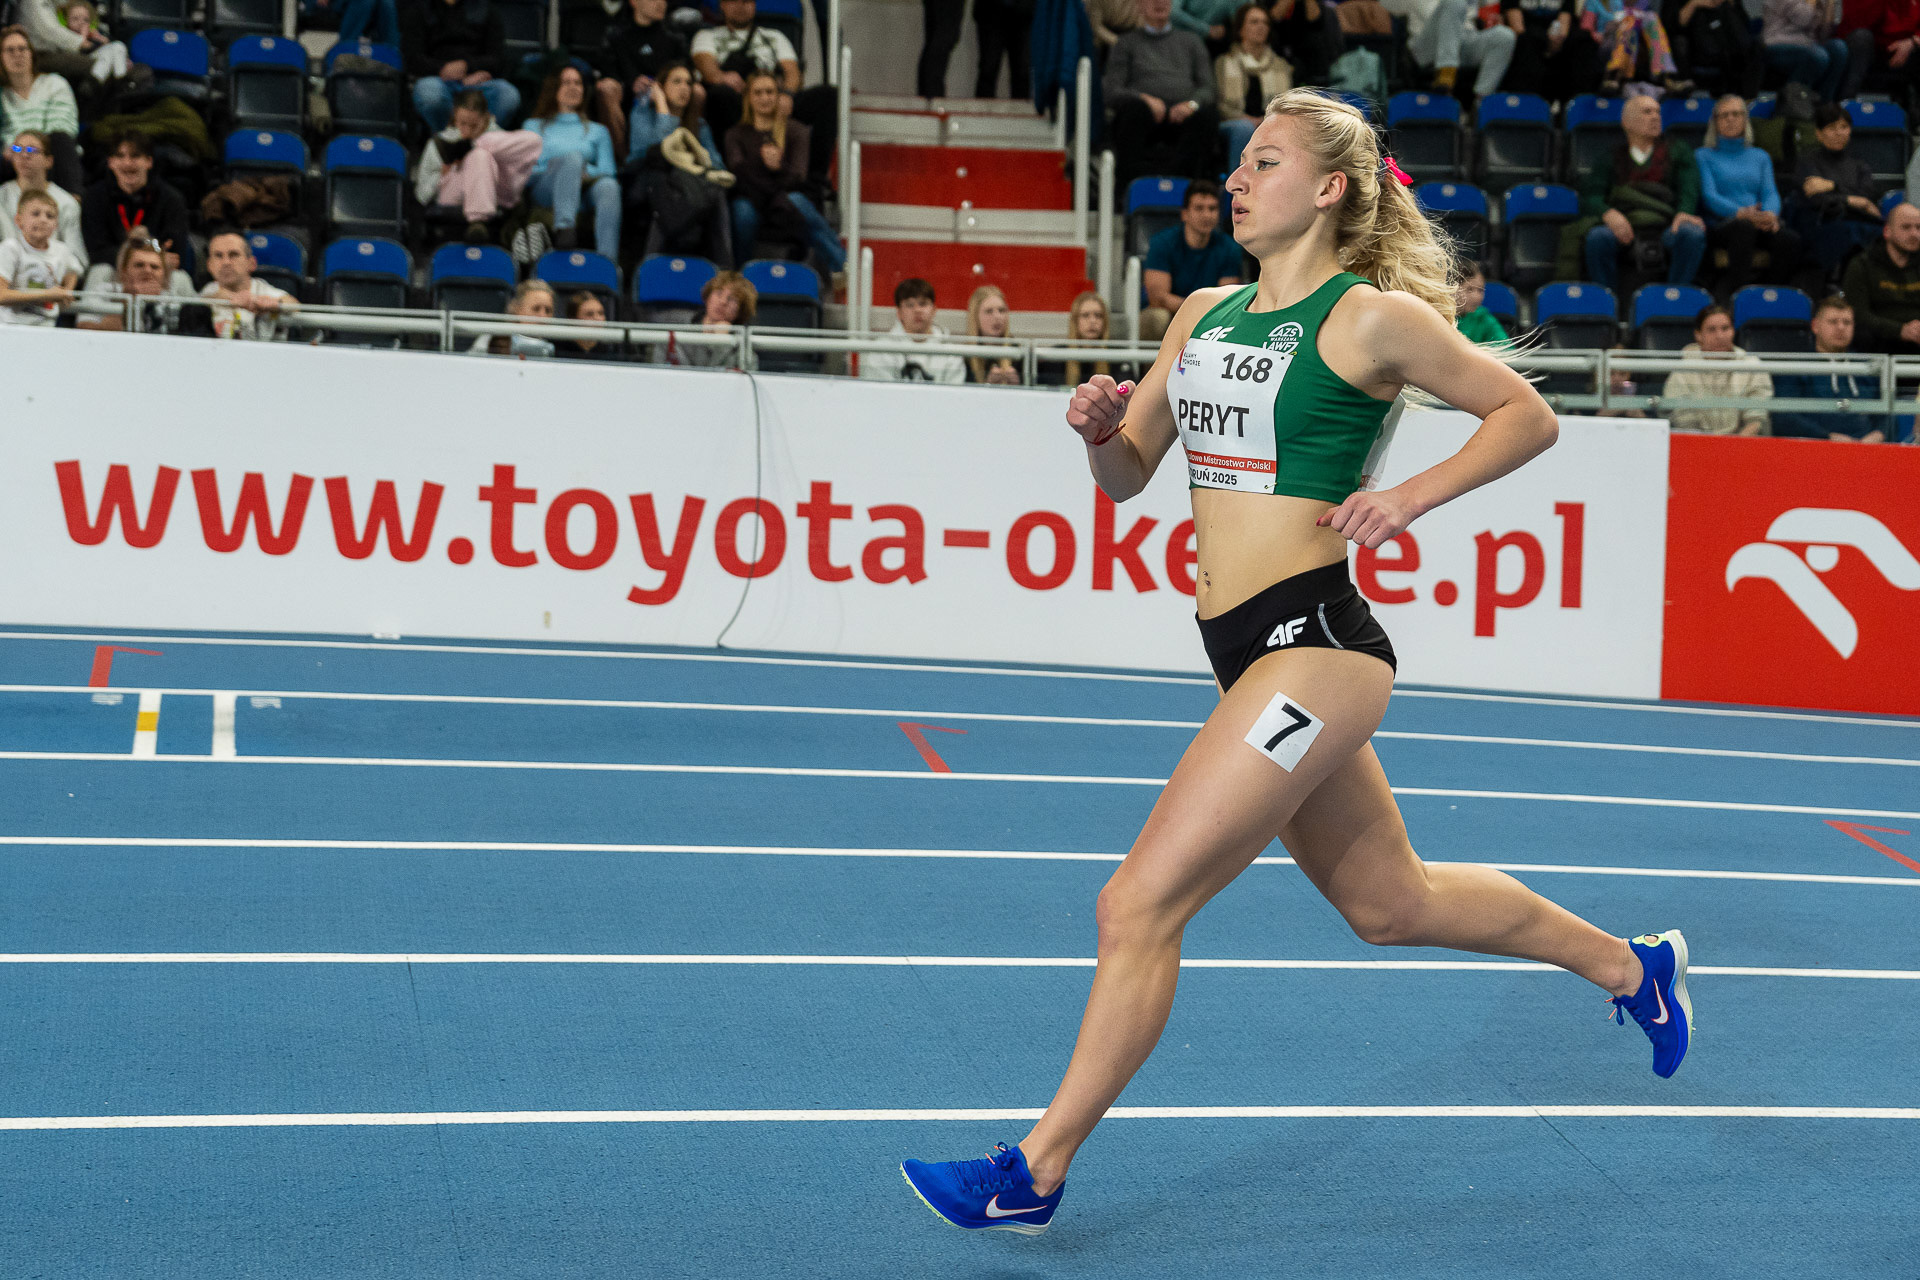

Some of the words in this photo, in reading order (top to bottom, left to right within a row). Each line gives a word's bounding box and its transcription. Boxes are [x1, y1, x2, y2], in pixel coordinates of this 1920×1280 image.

[1200, 326, 1236, 341] 4F
[1273, 327, 1298, 337] AZS
[1221, 352, 1273, 383] 168
[1179, 398, 1250, 438] PERYT
[1203, 455, 1245, 468] Mistrzostwa
[1246, 460, 1271, 471] Polski
[1211, 471, 1238, 485] 2025
[54, 460, 1585, 638] www.toyota-okee.pl
[1266, 616, 1308, 647] 4F
[1263, 702, 1312, 752] 7
